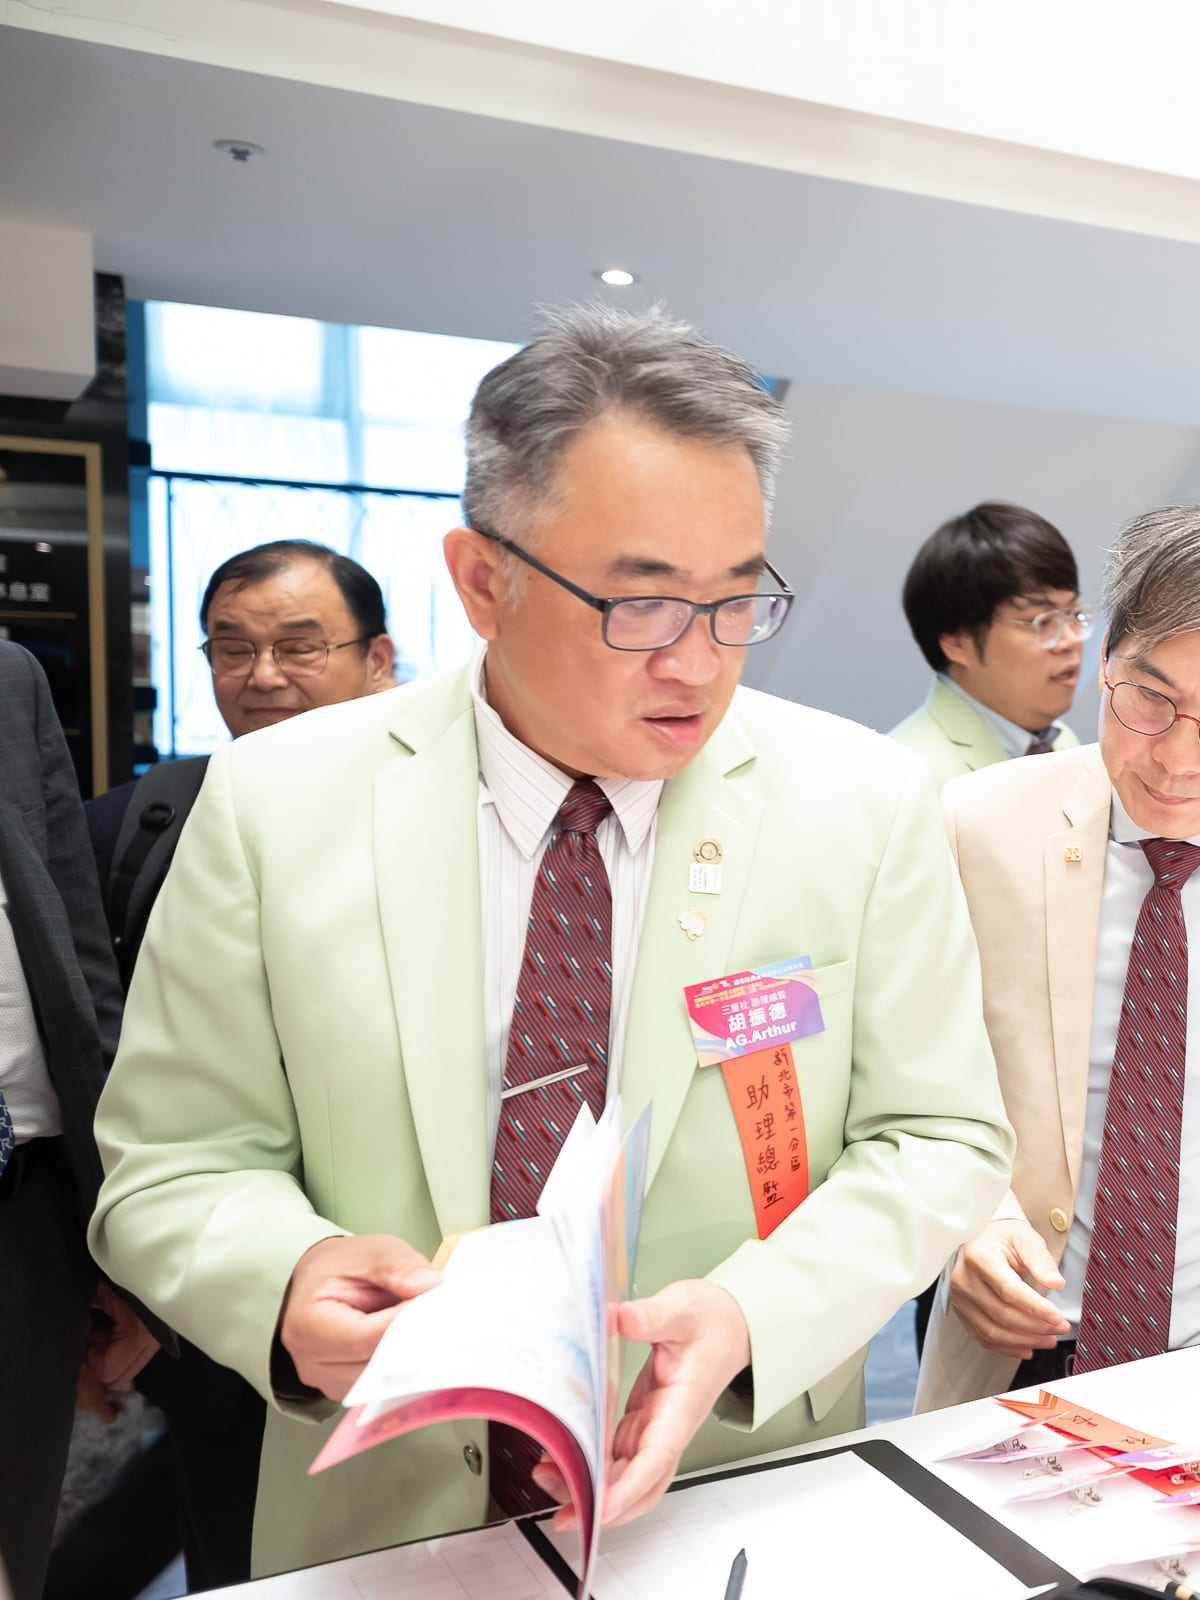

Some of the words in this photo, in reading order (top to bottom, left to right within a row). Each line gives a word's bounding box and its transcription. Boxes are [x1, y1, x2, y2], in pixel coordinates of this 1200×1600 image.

[727, 1002, 788, 1033] 胡振德
[726, 1021, 798, 1050] AG.Arthur
[746, 1075, 784, 1209] 助理總監
